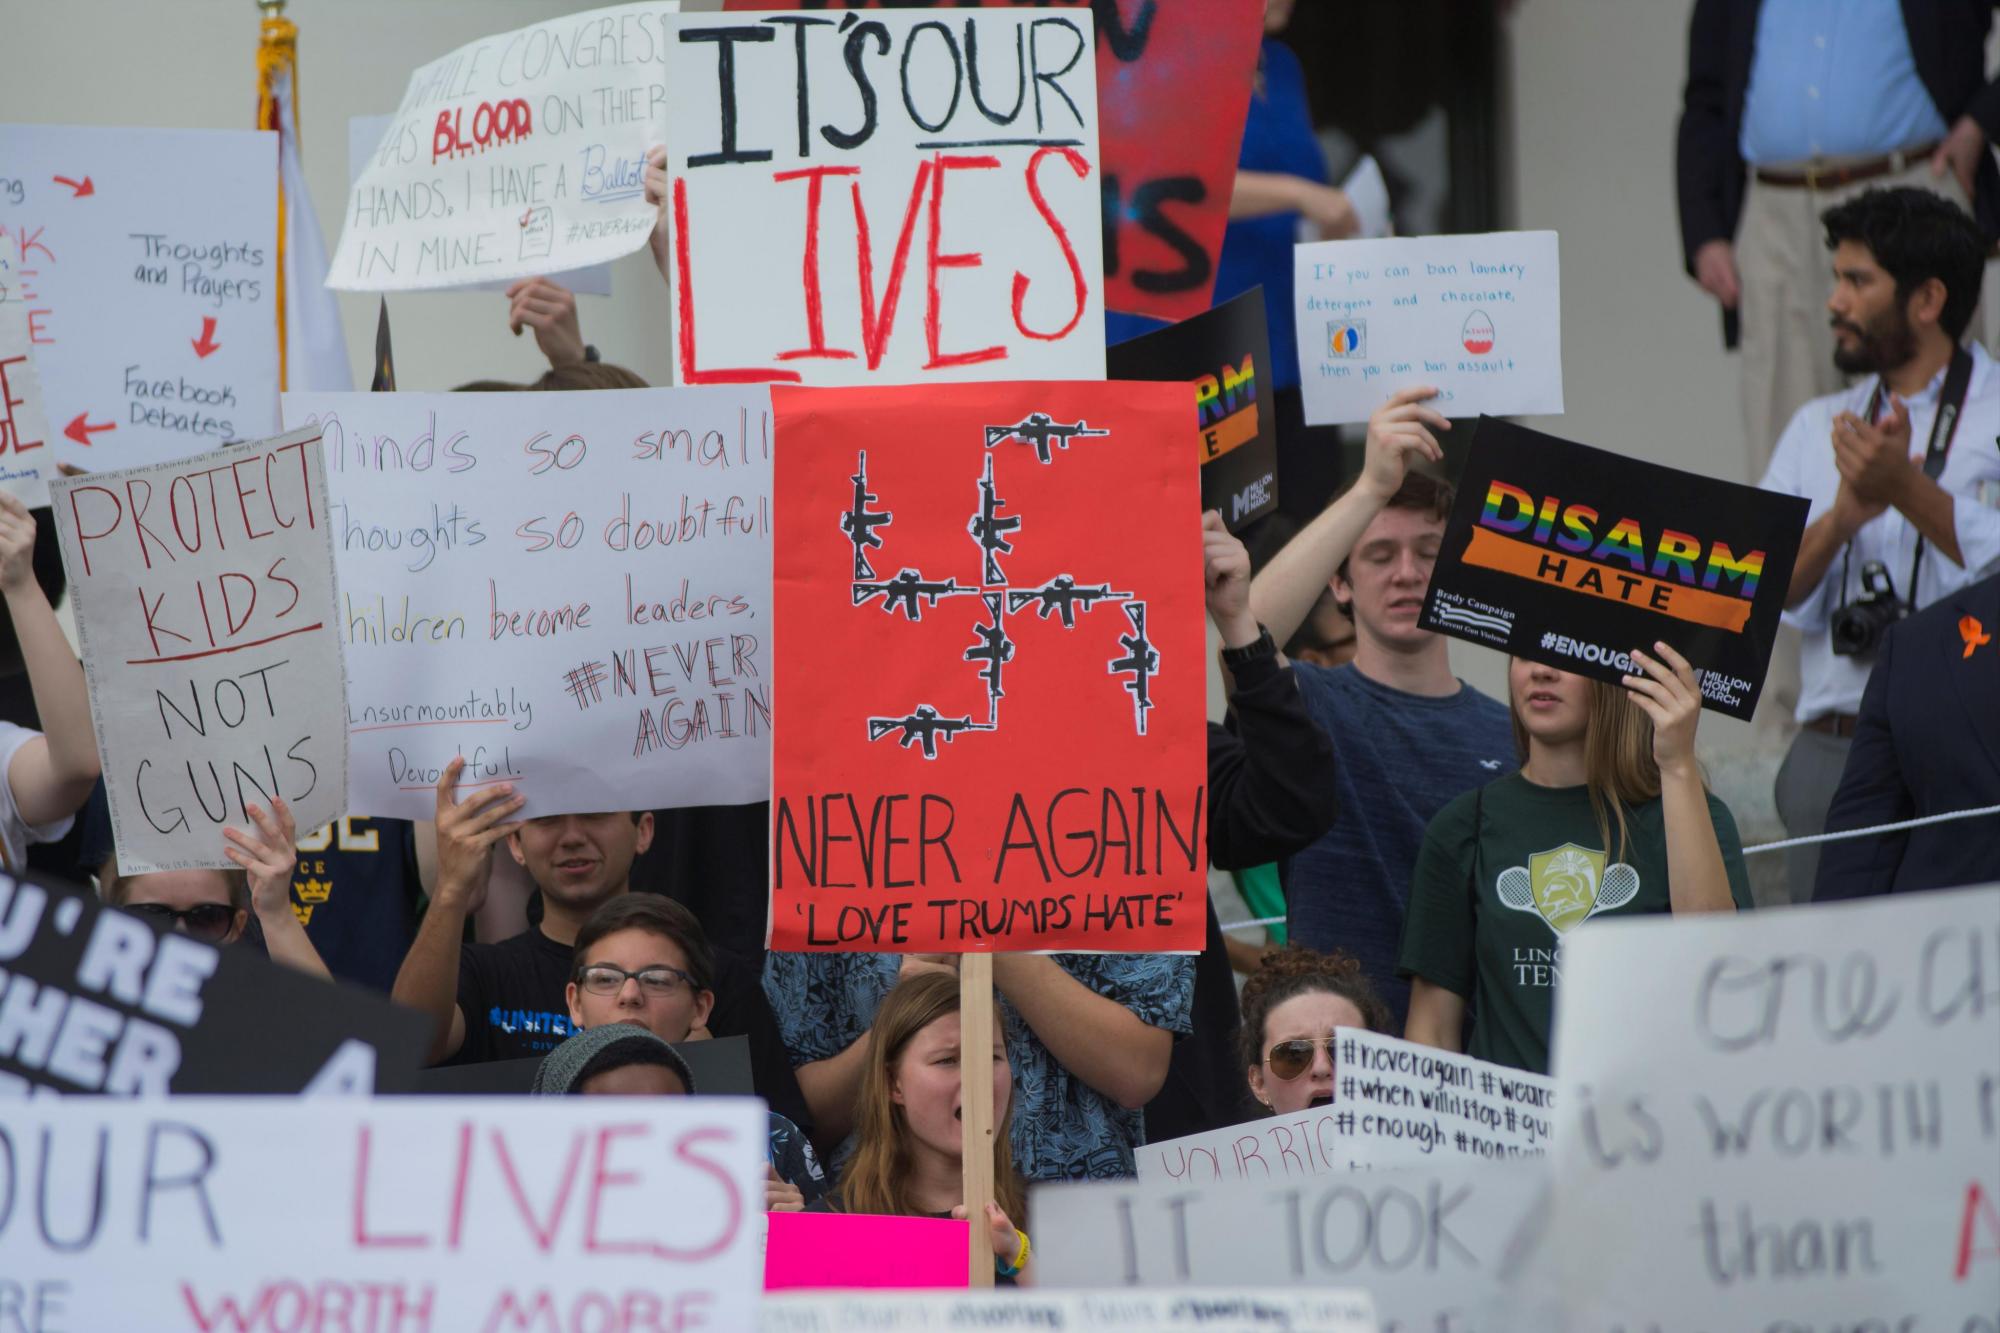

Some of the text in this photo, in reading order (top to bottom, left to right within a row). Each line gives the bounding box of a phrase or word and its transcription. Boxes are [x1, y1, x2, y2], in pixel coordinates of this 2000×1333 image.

[678, 12, 891, 168] IT'S
[900, 17, 1086, 133] OUR
[432, 98, 533, 165] BLOOD
[542, 95, 584, 136] ON
[489, 163, 548, 209] HAVE
[554, 163, 568, 199] A
[129, 233, 264, 270] Thoughts
[356, 242, 400, 278] IN
[416, 233, 502, 276] MINE.
[673, 146, 1091, 386] LIVES
[1313, 261, 1525, 285] If you can ban laundry
[134, 262, 261, 307] and Prayers
[1307, 296, 1371, 314] detergent
[1393, 294, 1418, 306] and
[125, 365, 236, 408] Facebook
[1320, 359, 1515, 382] then you can ban assault
[130, 402, 234, 438] Debates
[523, 429, 587, 475] so
[632, 405, 769, 470] small
[70, 436, 322, 577] PROTECT
[329, 492, 769, 572] houghts so doubtful
[1479, 479, 1766, 599] DISARM
[138, 557, 299, 656] KIDS
[343, 572, 756, 645] hildren become leaders,
[1436, 588, 1515, 619] Brady Campaign
[1537, 554, 1673, 611] HATE
[1438, 618, 1463, 631] Prevent
[1464, 625, 1478, 636] Gun
[1480, 629, 1508, 645] Violence
[156, 660, 289, 739] NOT
[562, 634, 760, 711] #NEVER
[1700, 687, 1741, 707] MARCH
[1701, 679, 1731, 695] MOM
[1705, 670, 1752, 692] MILLION
[633, 684, 770, 760] AGAIN
[136, 736, 316, 834] GUNS
[775, 785, 1204, 889] NEVER AGAIN
[928, 894, 1076, 941] TRUMPS
[0, 966, 182, 1097] HER
[1341, 1038, 1474, 1090] #neveragain
[1335, 1110, 1447, 1154] #enough
[351, 1120, 744, 1264] LIVES
[1117, 1178, 1481, 1288] IT TOOK
